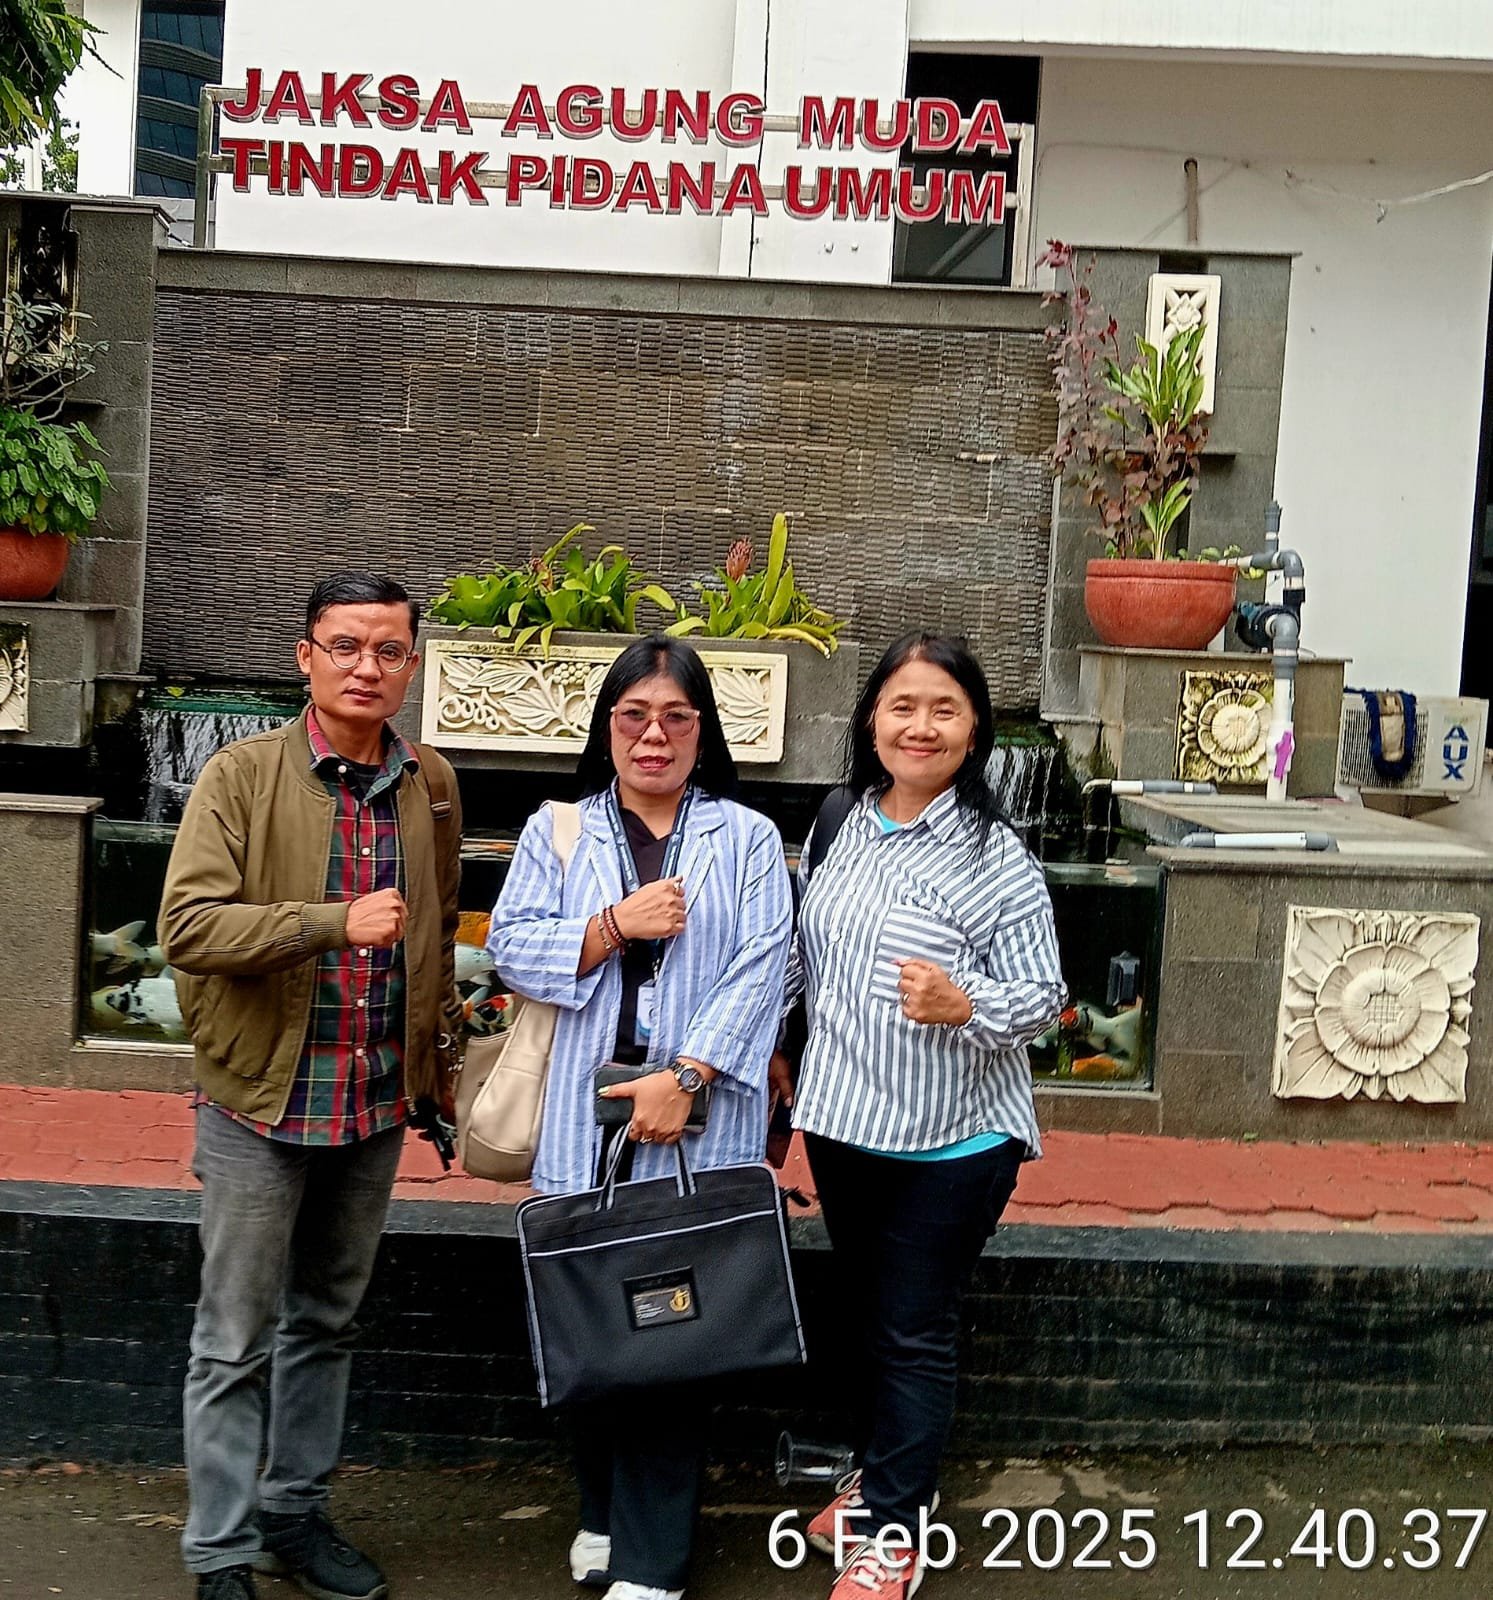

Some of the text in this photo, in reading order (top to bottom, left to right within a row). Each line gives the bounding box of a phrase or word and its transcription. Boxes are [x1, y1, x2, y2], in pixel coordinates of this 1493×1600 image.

[220, 68, 1013, 157] JAKSA AGUNG MUDA
[219, 137, 1006, 226] TINDAK PIDANA UMUM
[1442, 725, 1469, 781] AUX
